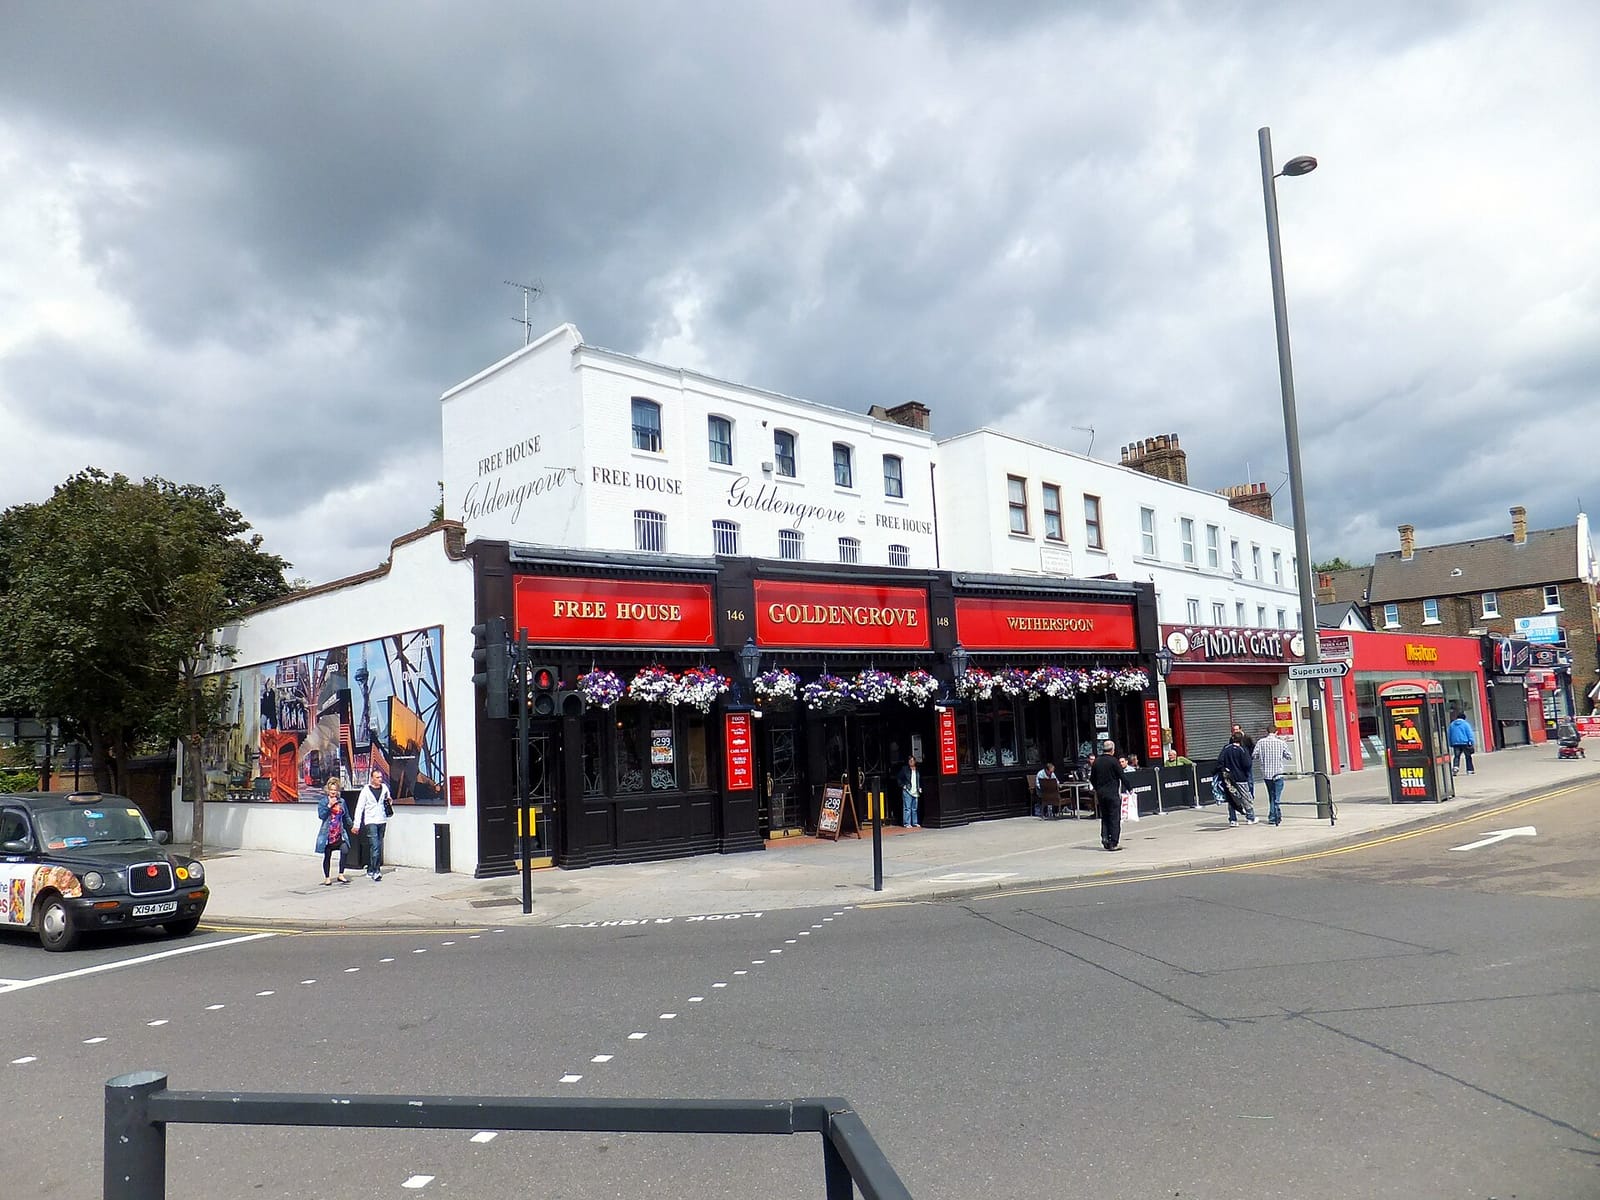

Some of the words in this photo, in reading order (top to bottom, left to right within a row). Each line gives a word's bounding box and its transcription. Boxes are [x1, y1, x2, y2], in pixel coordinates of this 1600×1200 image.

[478, 451, 503, 477] FREE
[505, 434, 541, 465] HOUSE
[592, 466, 632, 487] FREE
[635, 473, 683, 495] HOUSE
[461, 468, 566, 525] Goldengrove
[727, 476, 846, 529] Goldengrove
[875, 513, 901, 530] FREE
[902, 519, 933, 535] HOUSE
[553, 600, 607, 619] FREE
[615, 603, 683, 622] HOUSE
[726, 610, 745, 621] 146
[768, 603, 919, 627] GOLDENGROVE
[936, 616, 949, 627] 148
[1006, 616, 1095, 632] WETHERSPOON
[1205, 634, 1248, 658] INDIA
[1250, 635, 1284, 657] GATE
[1292, 667, 1338, 677] Superstore
[1400, 768, 1424, 778] NEW
[1401, 778, 1425, 788] STILL
[159, 902, 175, 912] YGU
[685, 912, 763, 922] LOOK
